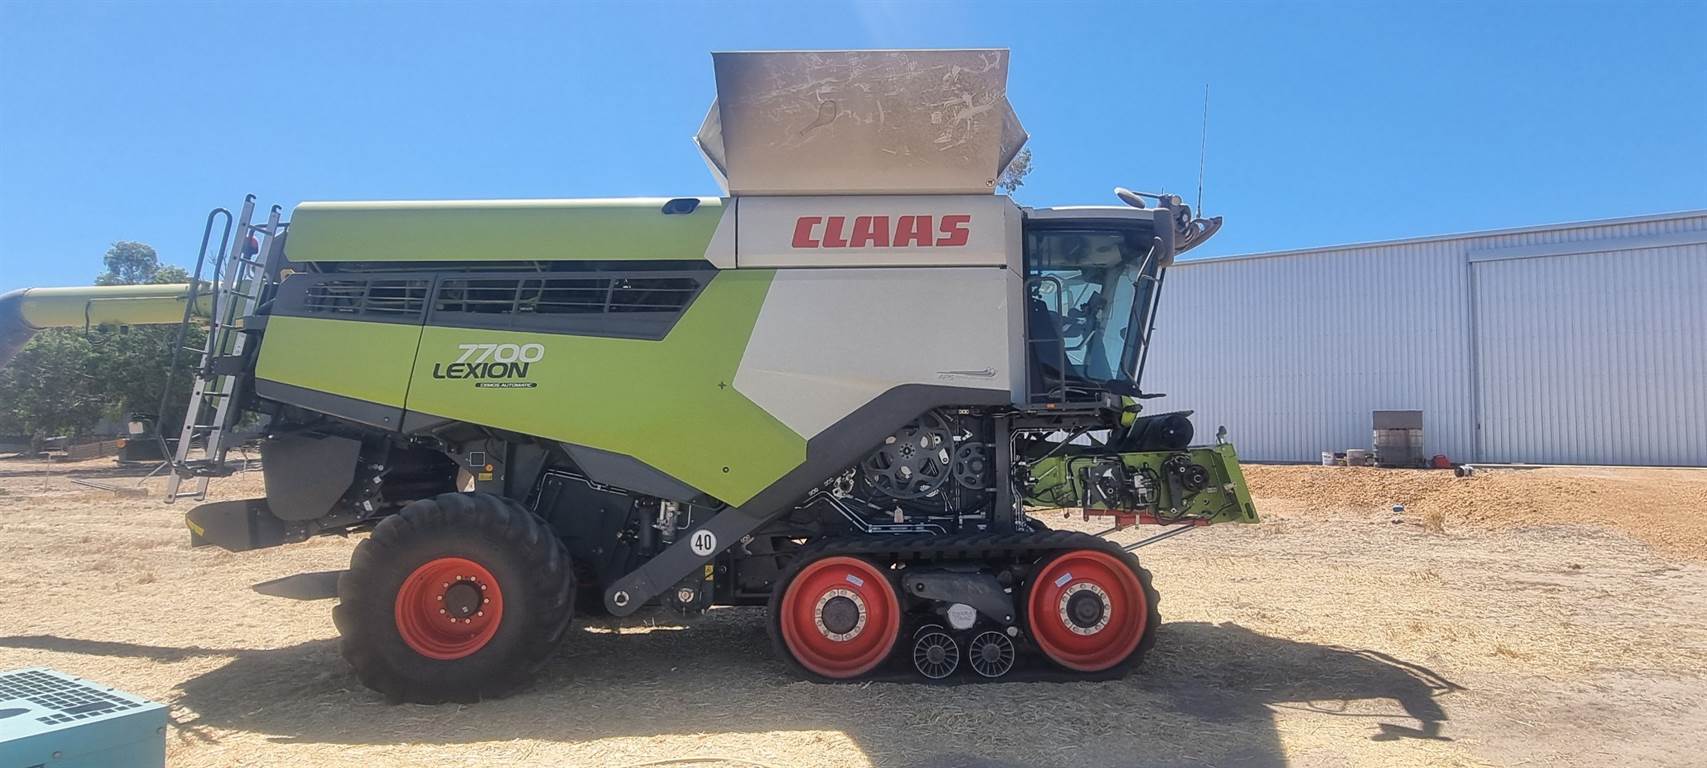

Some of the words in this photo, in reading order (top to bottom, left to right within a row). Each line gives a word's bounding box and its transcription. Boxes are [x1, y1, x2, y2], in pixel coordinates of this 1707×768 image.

[791, 215, 971, 248] CLAAS
[455, 343, 545, 363] 7700
[433, 362, 529, 379] LEXION
[695, 534, 711, 550] 40
